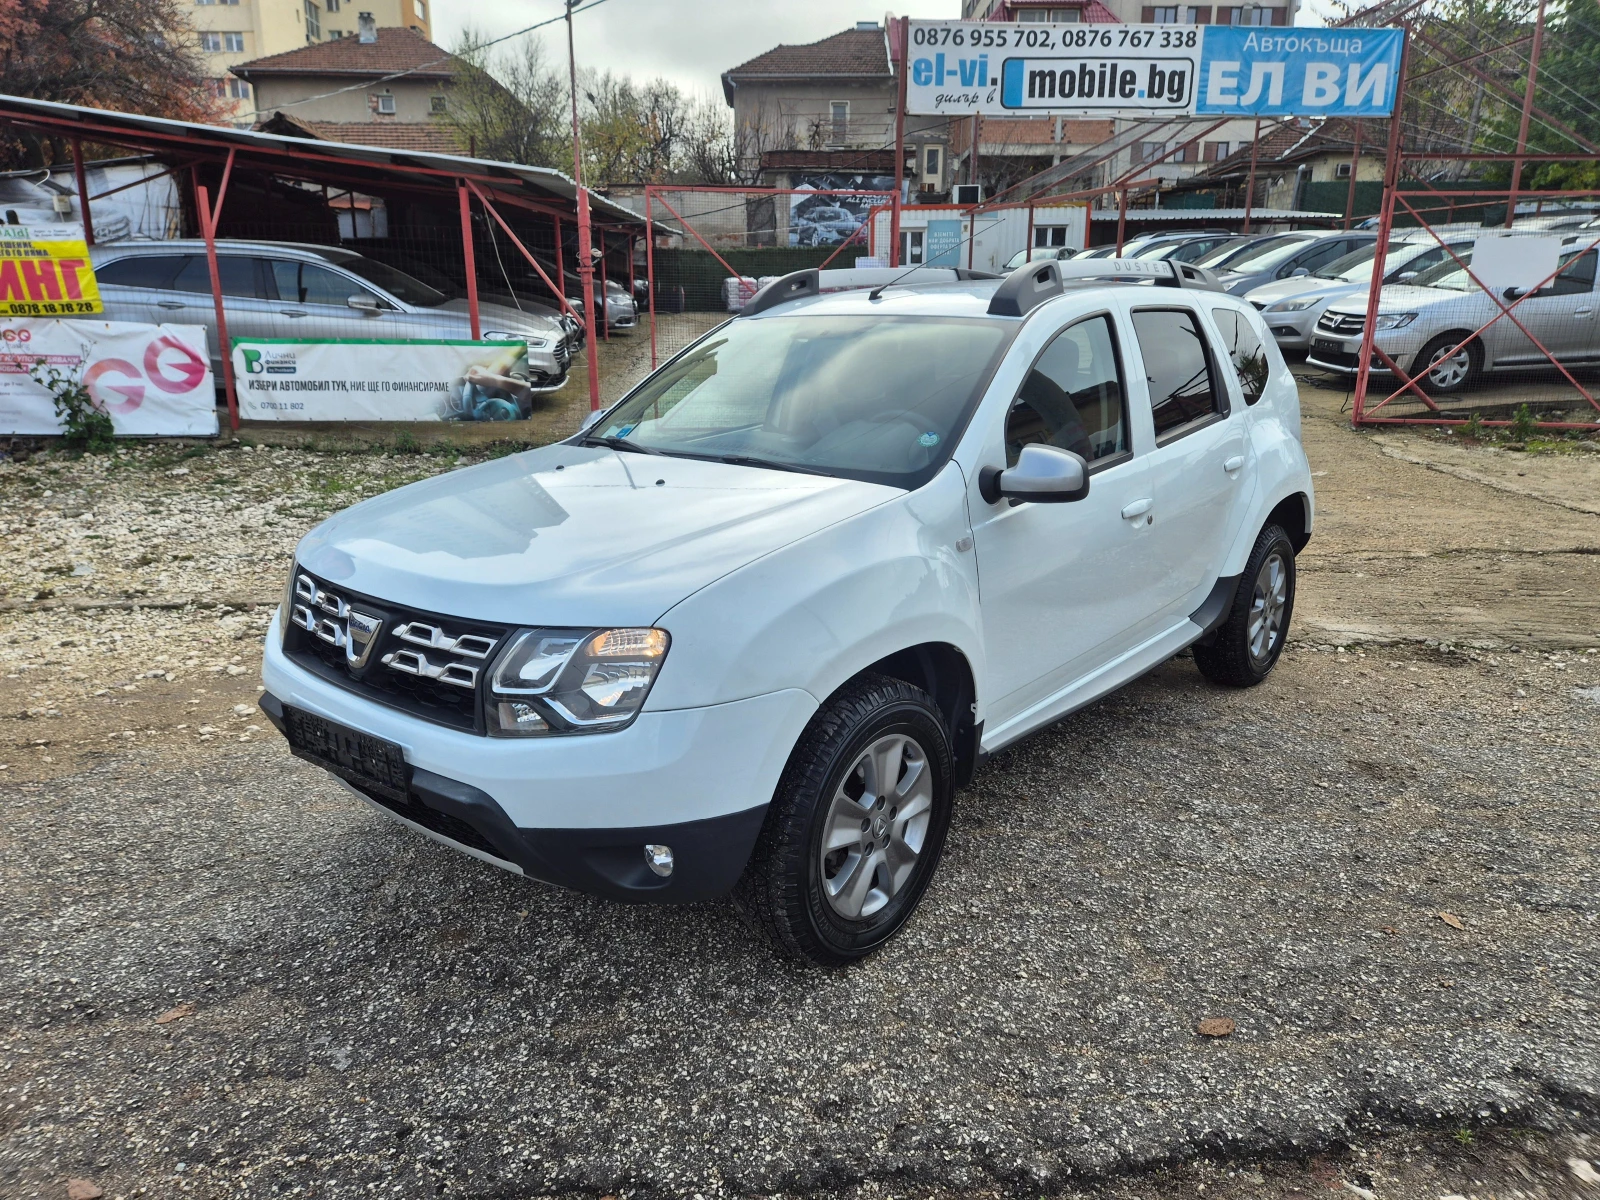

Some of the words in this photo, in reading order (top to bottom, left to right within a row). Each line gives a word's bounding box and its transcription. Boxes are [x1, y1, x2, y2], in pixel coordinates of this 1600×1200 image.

[913, 28, 965, 46] 0876
[970, 29, 1007, 48] 955
[1014, 30, 1056, 50] 702,
[1062, 29, 1112, 48] 0876
[1118, 30, 1155, 48] 767
[1160, 30, 1197, 48] 338
[1242, 31, 1363, 57] Автокъща
[1028, 62, 1186, 103] mobile.bg
[1205, 60, 1286, 106] ЕЛ
[1301, 61, 1389, 107] ВИ
[935, 91, 979, 109] дилър
[986, 87, 997, 104] в
[1113, 261, 1169, 274] DUSTER
[9, 303, 41, 315] 0878
[42, 303, 58, 314] 18
[59, 303, 75, 313] 78
[76, 302, 94, 312] 28
[264, 350, 296, 359] Лични
[248, 380, 277, 391] ИЗБЕРИ
[280, 380, 330, 392] АВТОМОБИЛ
[331, 380, 349, 393] ТУК,
[350, 381, 366, 392] НИЕ
[367, 381, 380, 393] ЩЕ
[381, 382, 391, 392] ГО
[391, 381, 450, 393] ФИНАНСИРАМЕ
[261, 402, 277, 410] 0700
[279, 402, 288, 410] 11
[290, 402, 304, 410] 802
